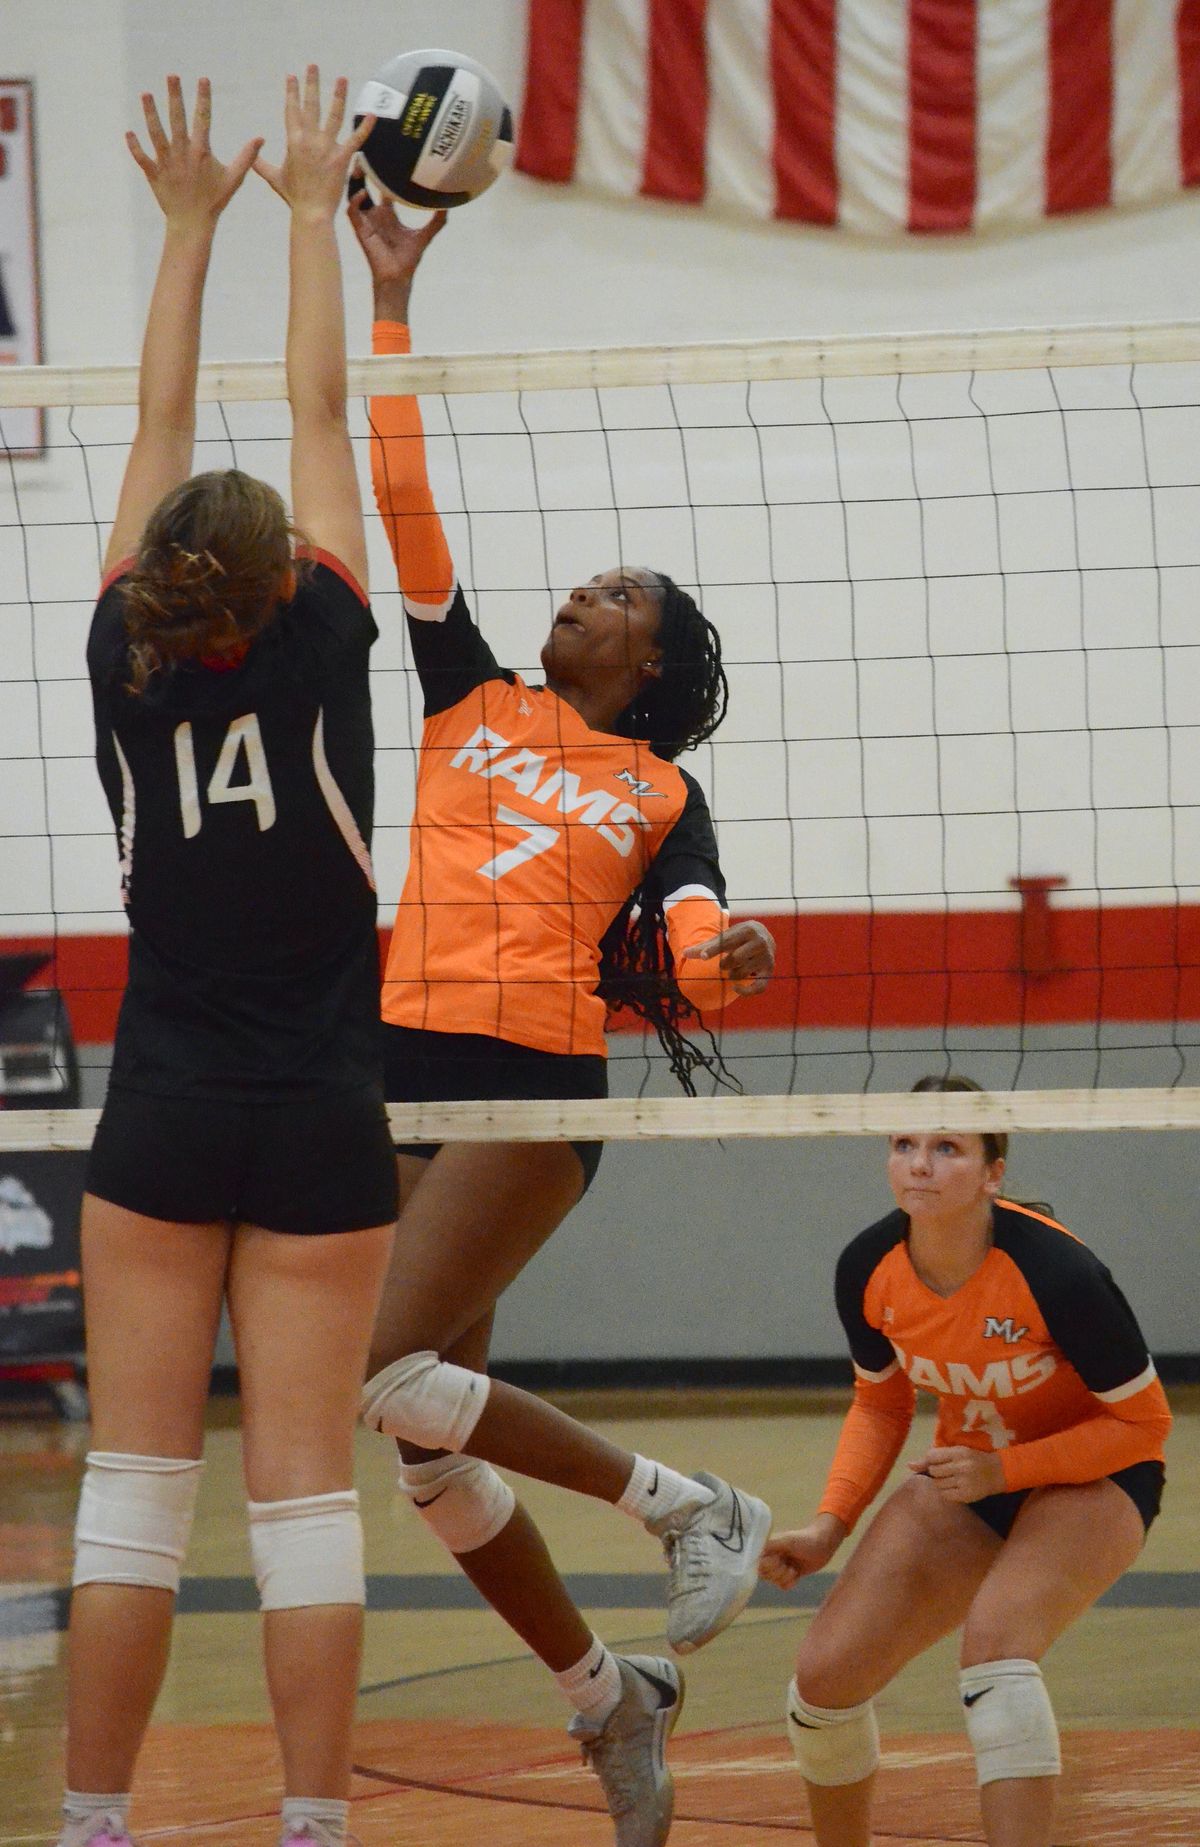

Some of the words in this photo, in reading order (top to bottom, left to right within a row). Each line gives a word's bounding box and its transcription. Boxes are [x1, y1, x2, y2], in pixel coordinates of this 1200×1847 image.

[174, 712, 277, 839] 14
[449, 724, 653, 858] RAMS
[475, 803, 561, 881] 7
